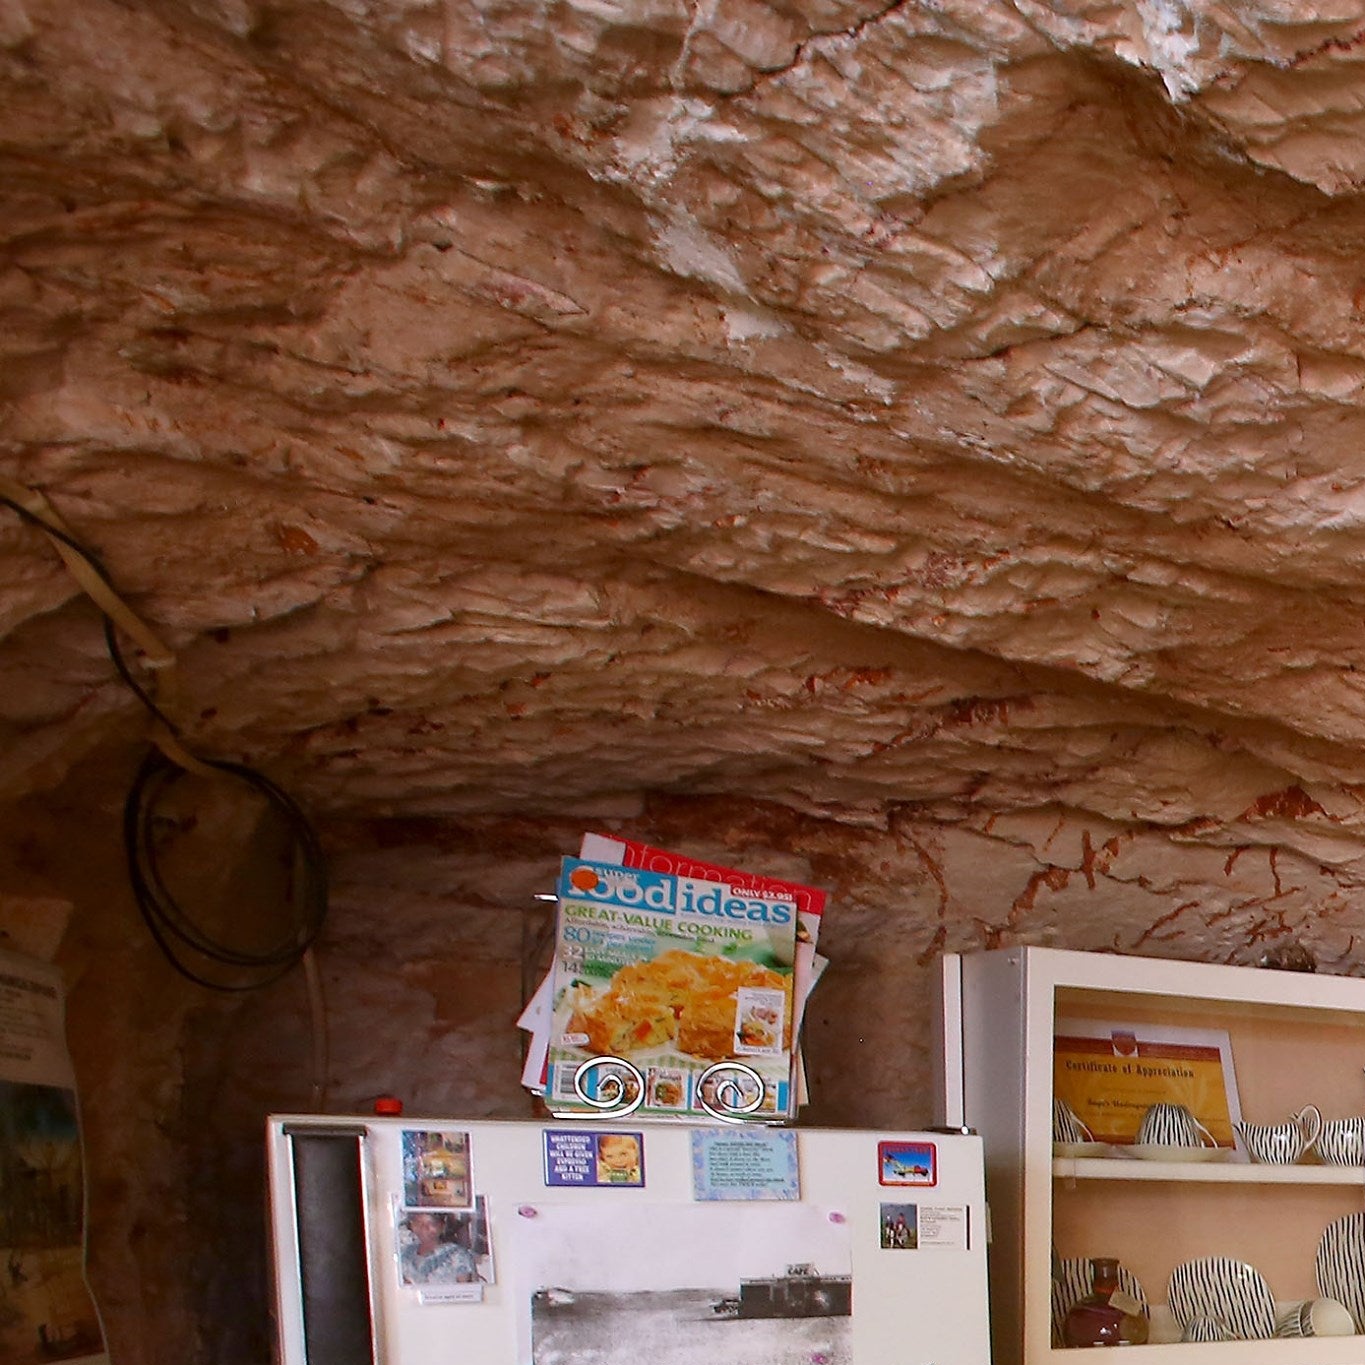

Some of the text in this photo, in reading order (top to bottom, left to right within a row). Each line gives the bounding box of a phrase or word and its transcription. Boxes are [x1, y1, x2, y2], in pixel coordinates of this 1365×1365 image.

[732, 886, 761, 898] ONLY
[681, 882, 792, 925] ideas
[564, 904, 673, 931] GREAT-VALUE
[677, 921, 753, 941] COOKING
[564, 926, 591, 942] 80
[1065, 1060, 1195, 1078] Certificate of Appreciation
